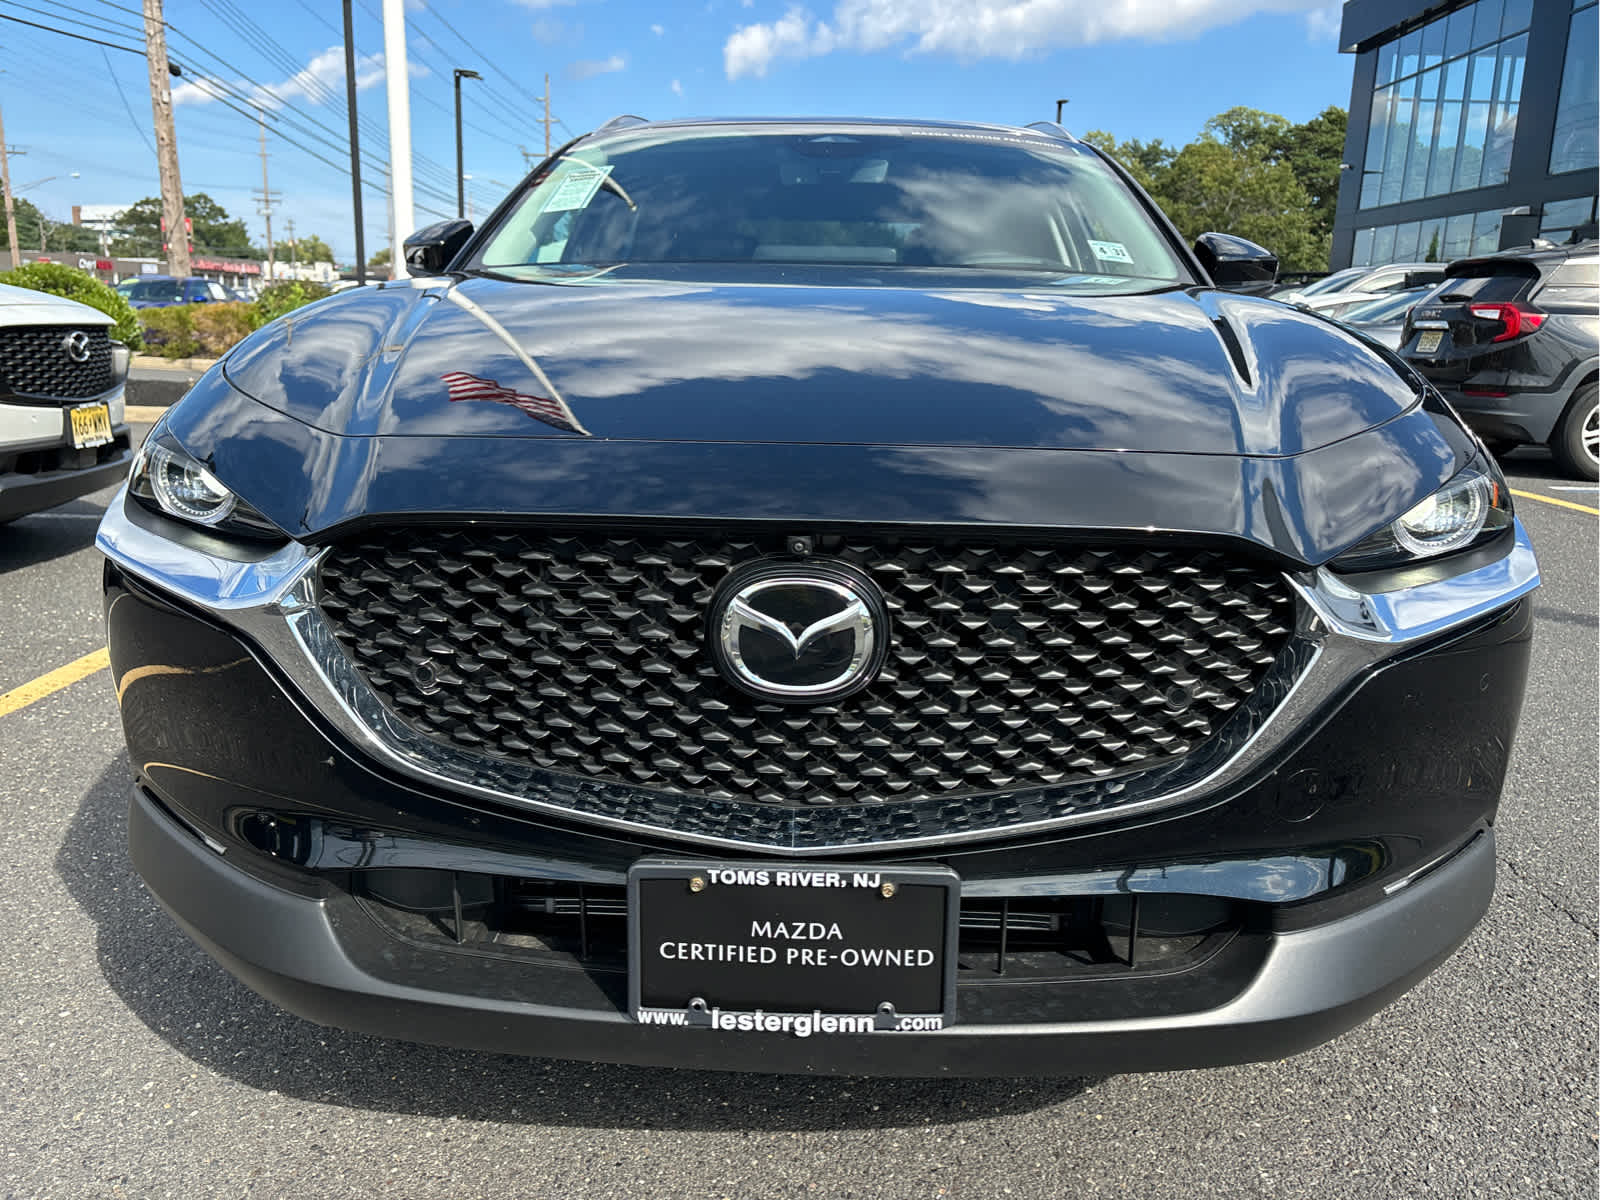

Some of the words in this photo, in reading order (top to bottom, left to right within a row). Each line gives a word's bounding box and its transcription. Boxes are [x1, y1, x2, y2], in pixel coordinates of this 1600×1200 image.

[707, 869, 770, 886] TOMS
[776, 872, 846, 888] RIVER,
[853, 873, 881, 888] NJ
[750, 920, 844, 941] MAZDA
[659, 941, 777, 965] CERTIFIED
[786, 949, 935, 967] PRE-OWNED
